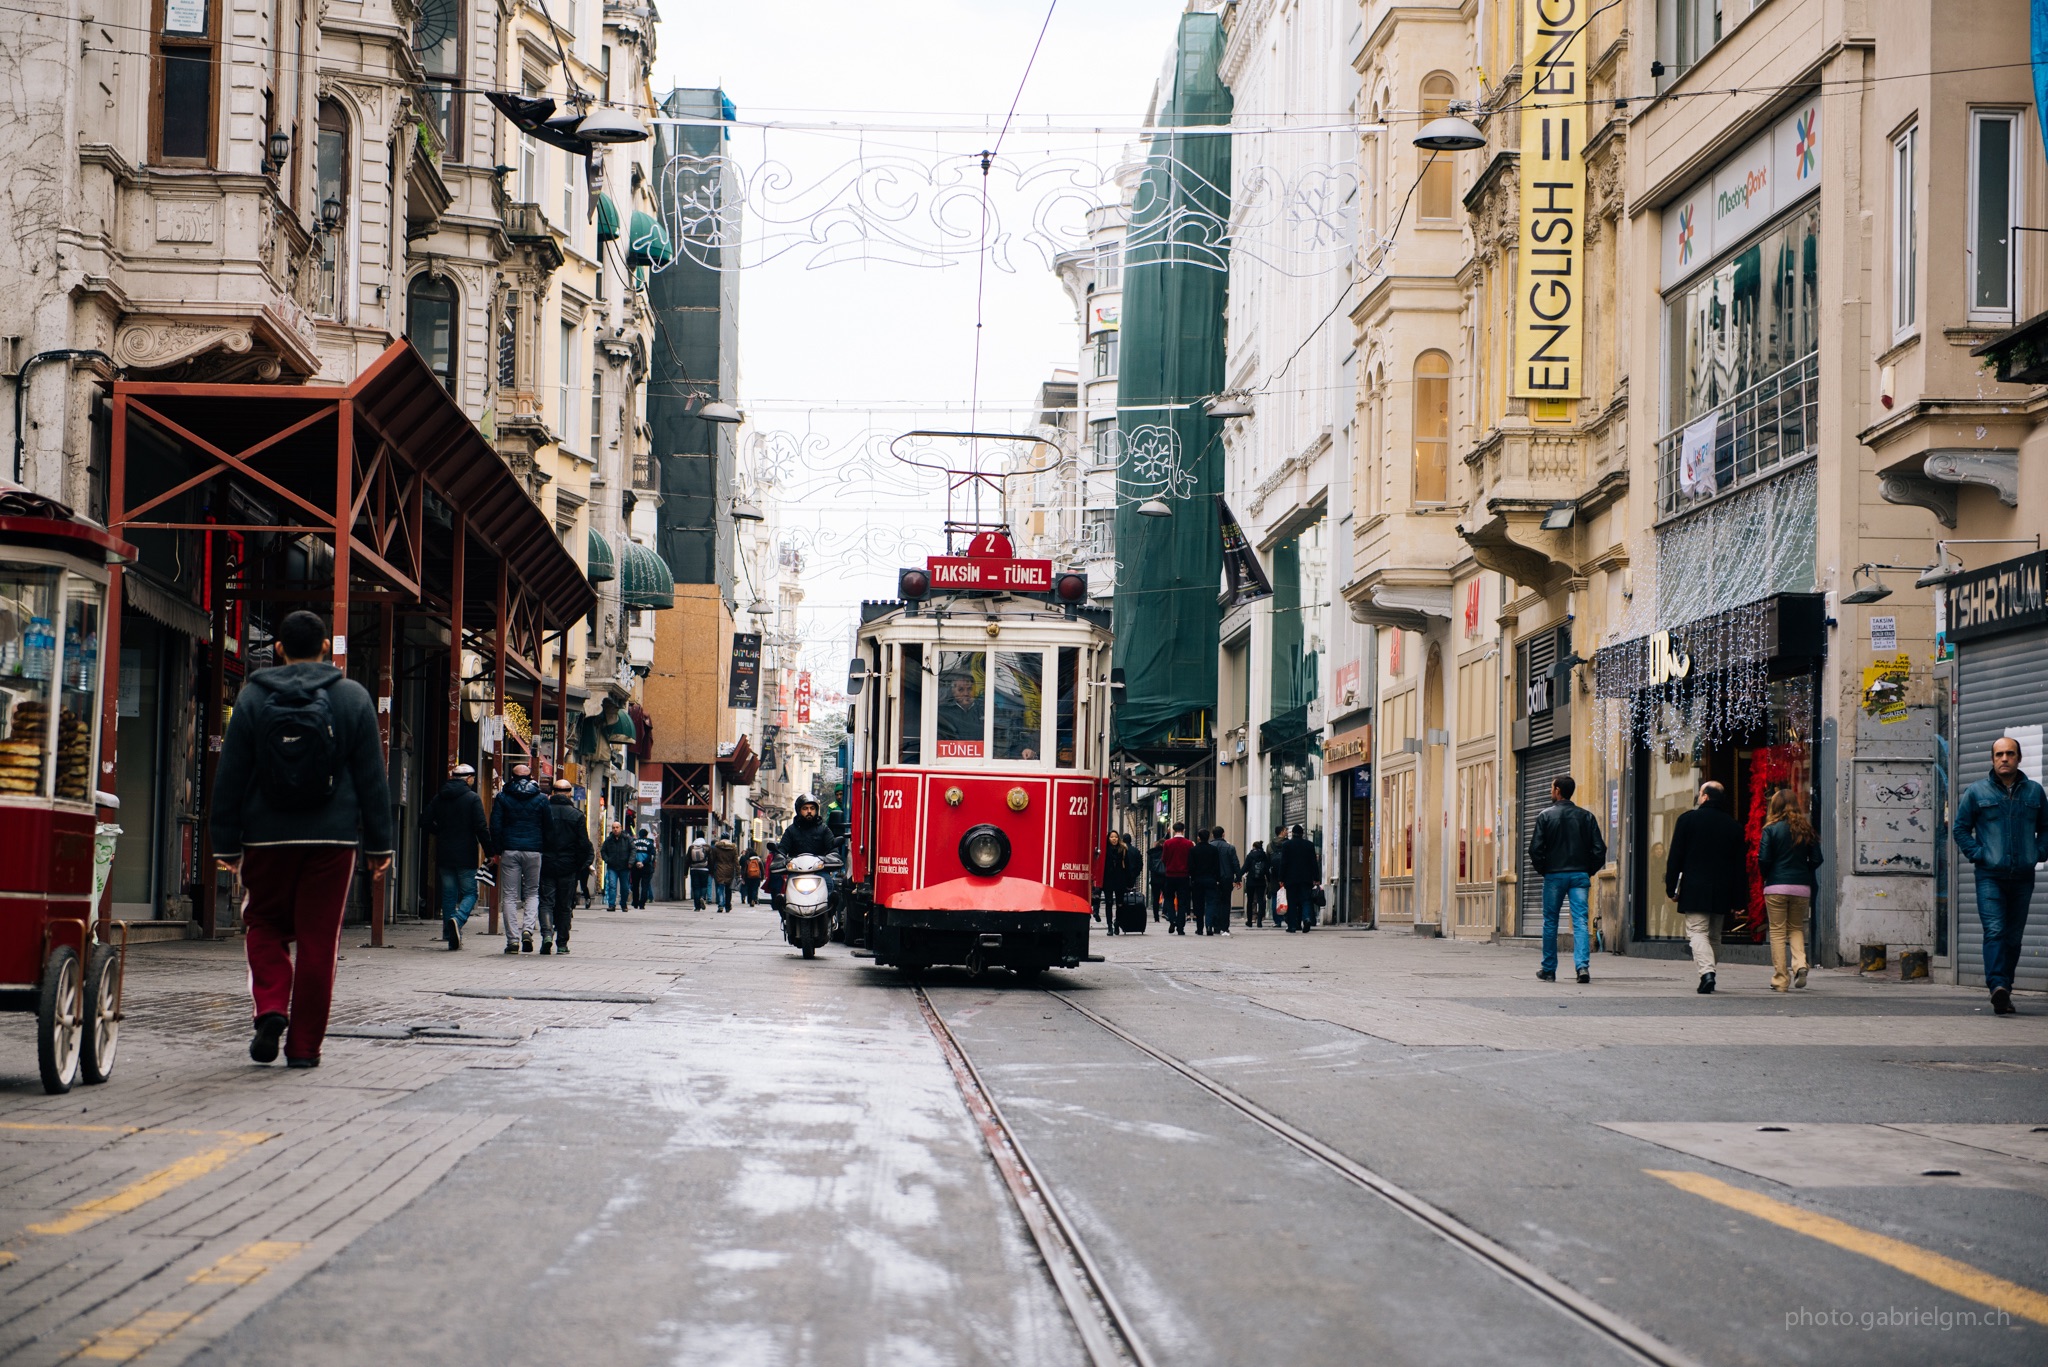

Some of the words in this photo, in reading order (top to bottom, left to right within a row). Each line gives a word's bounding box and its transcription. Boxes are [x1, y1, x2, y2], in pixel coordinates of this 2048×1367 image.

[1528, 182, 1574, 391] ENGLISH
[985, 534, 996, 553] 2
[933, 563, 980, 582] TAKSİM
[1003, 564, 1047, 585] TÜNEL
[1465, 577, 1480, 639] H&M
[800, 682, 809, 714] CHP
[1527, 674, 1548, 715] batik
[940, 742, 981, 756] TÜNEL
[883, 789, 903, 809] 223
[1069, 796, 1088, 816] 223
[891, 857, 908, 866] YASAK
[1058, 871, 1067, 880] VE
